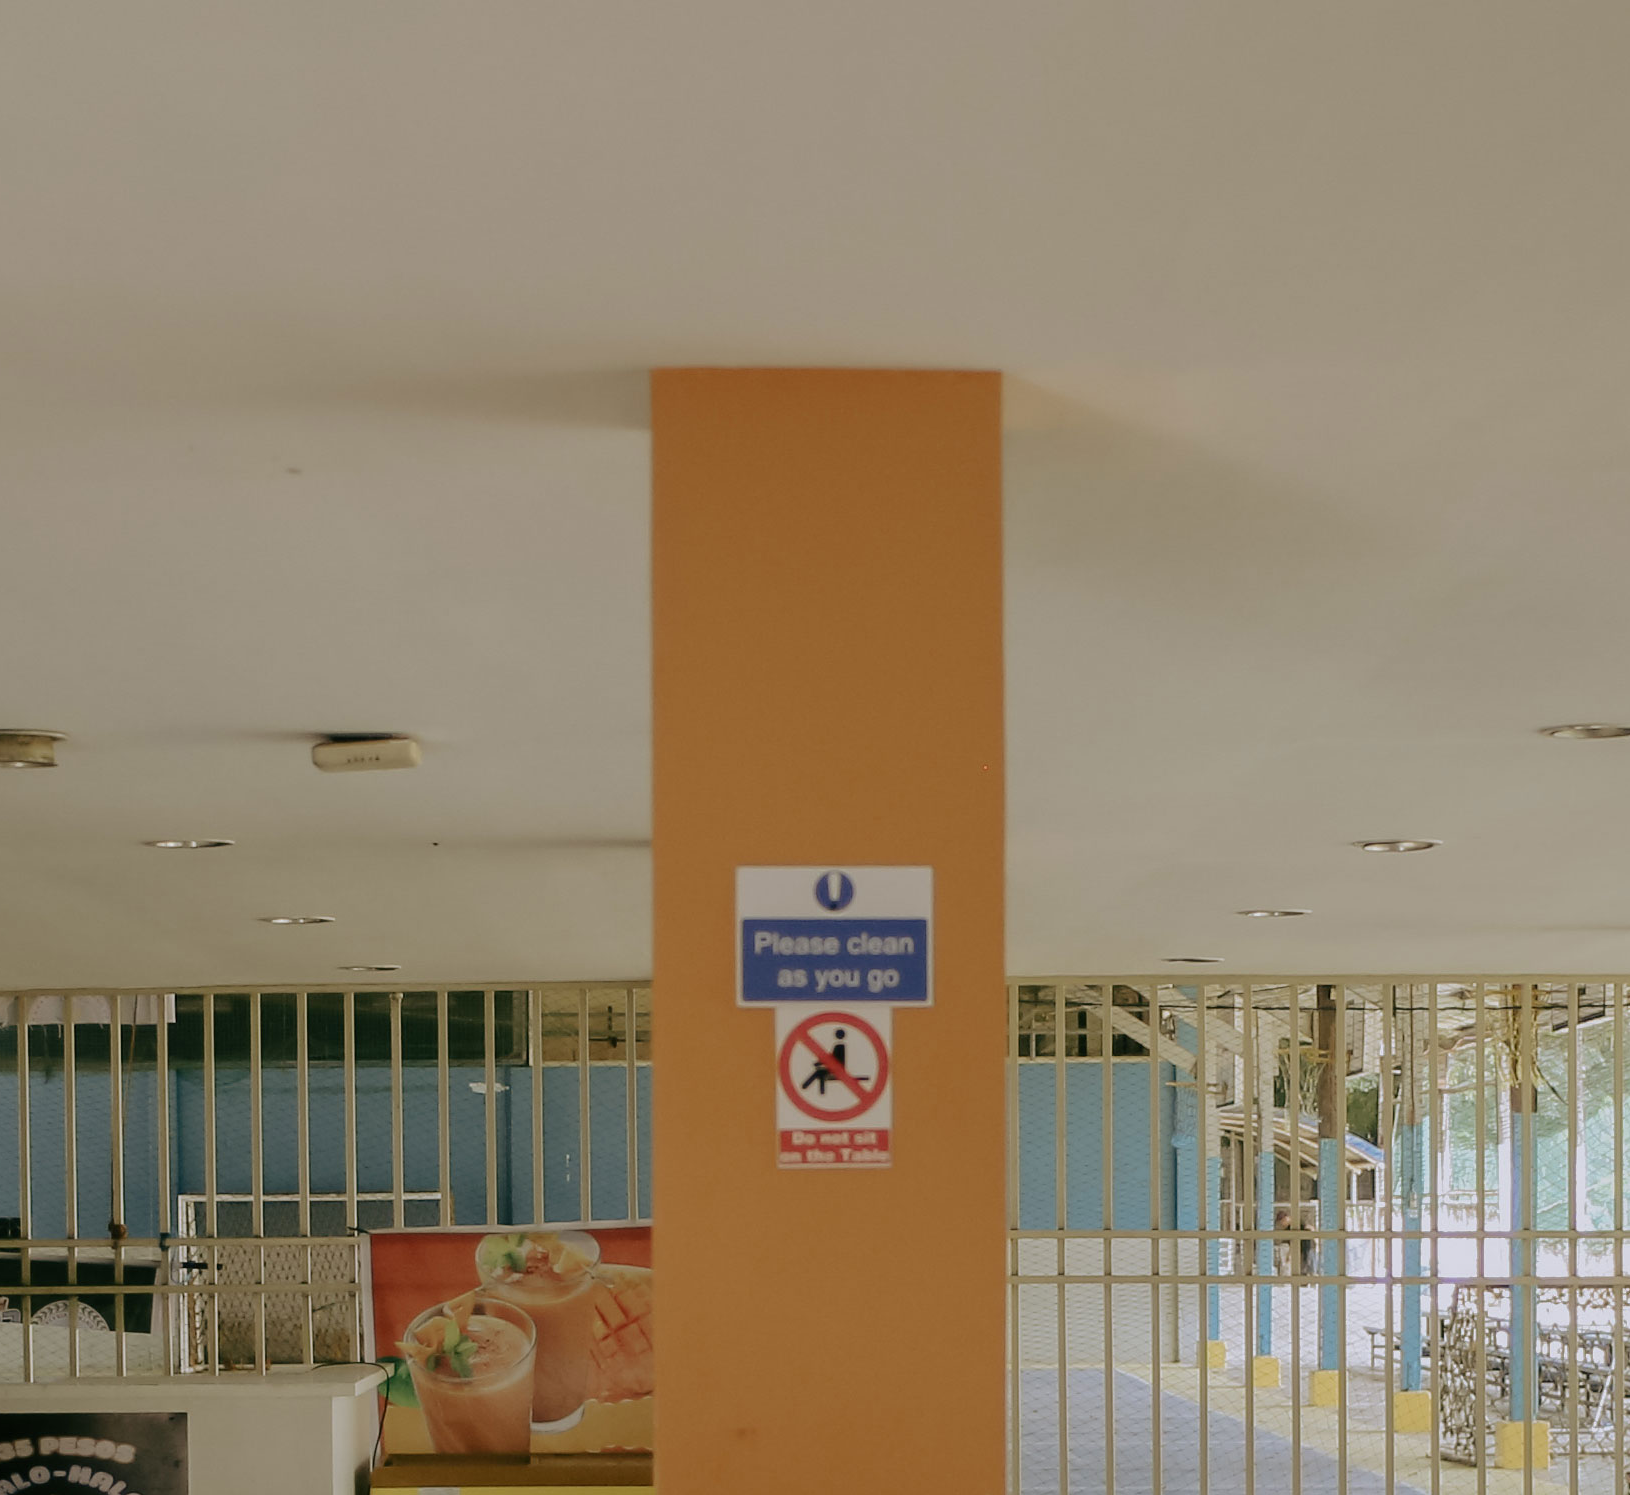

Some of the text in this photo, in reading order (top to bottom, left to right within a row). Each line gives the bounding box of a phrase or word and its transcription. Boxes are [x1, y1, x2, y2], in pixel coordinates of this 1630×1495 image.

[753, 931, 914, 955] Please clean
[777, 968, 901, 993] as you go
[792, 1131, 877, 1145] Do not sit
[779, 1151, 802, 1162] on
[805, 1149, 836, 1162] the
[38, 1436, 137, 1464] PESOS
